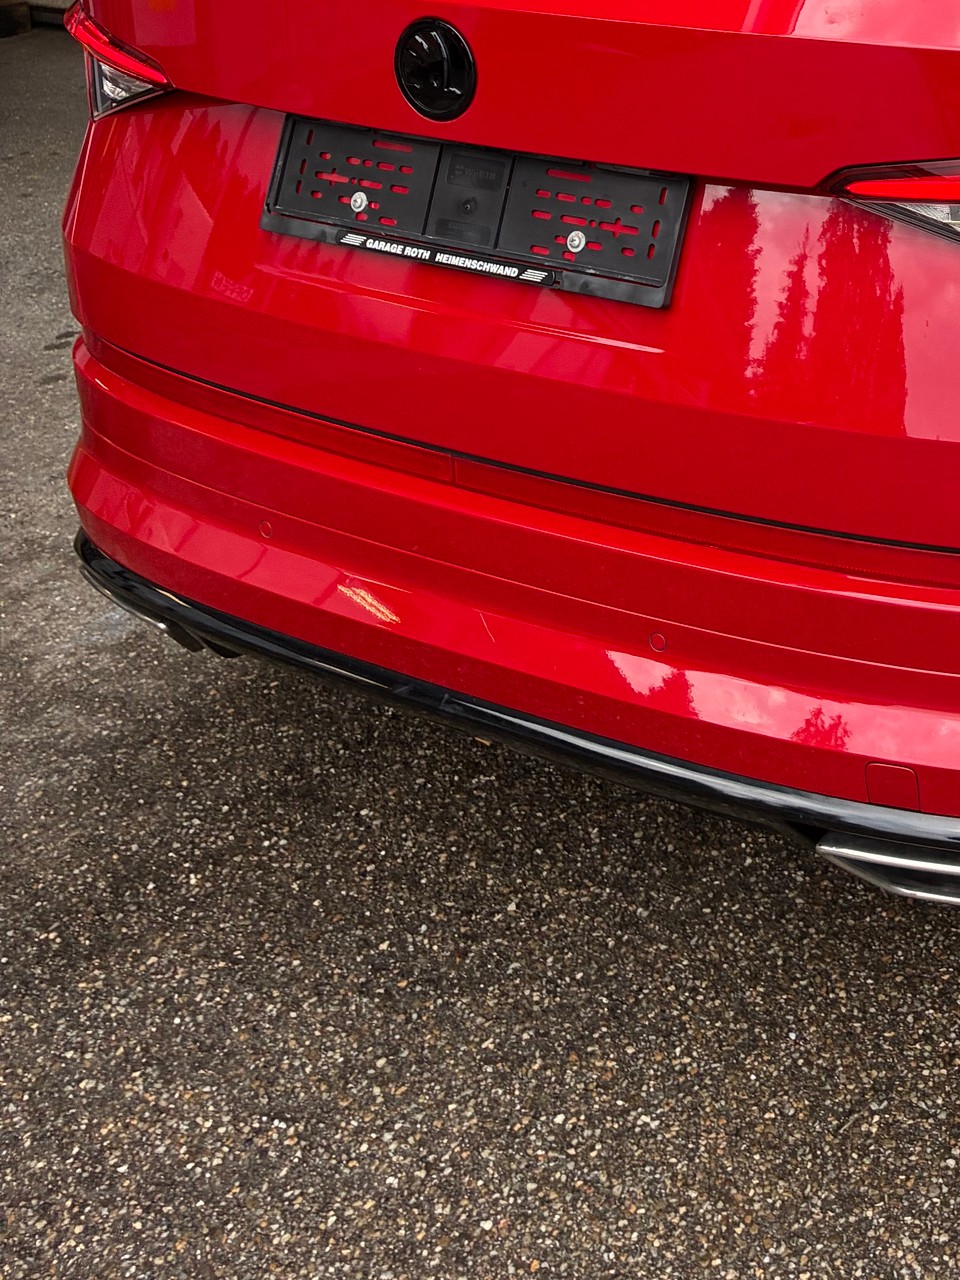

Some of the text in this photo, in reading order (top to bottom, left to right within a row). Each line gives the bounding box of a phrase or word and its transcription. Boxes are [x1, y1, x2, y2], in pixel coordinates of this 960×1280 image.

[365, 238, 519, 278] GARAGE ROTH HEIMENSCHWAND
